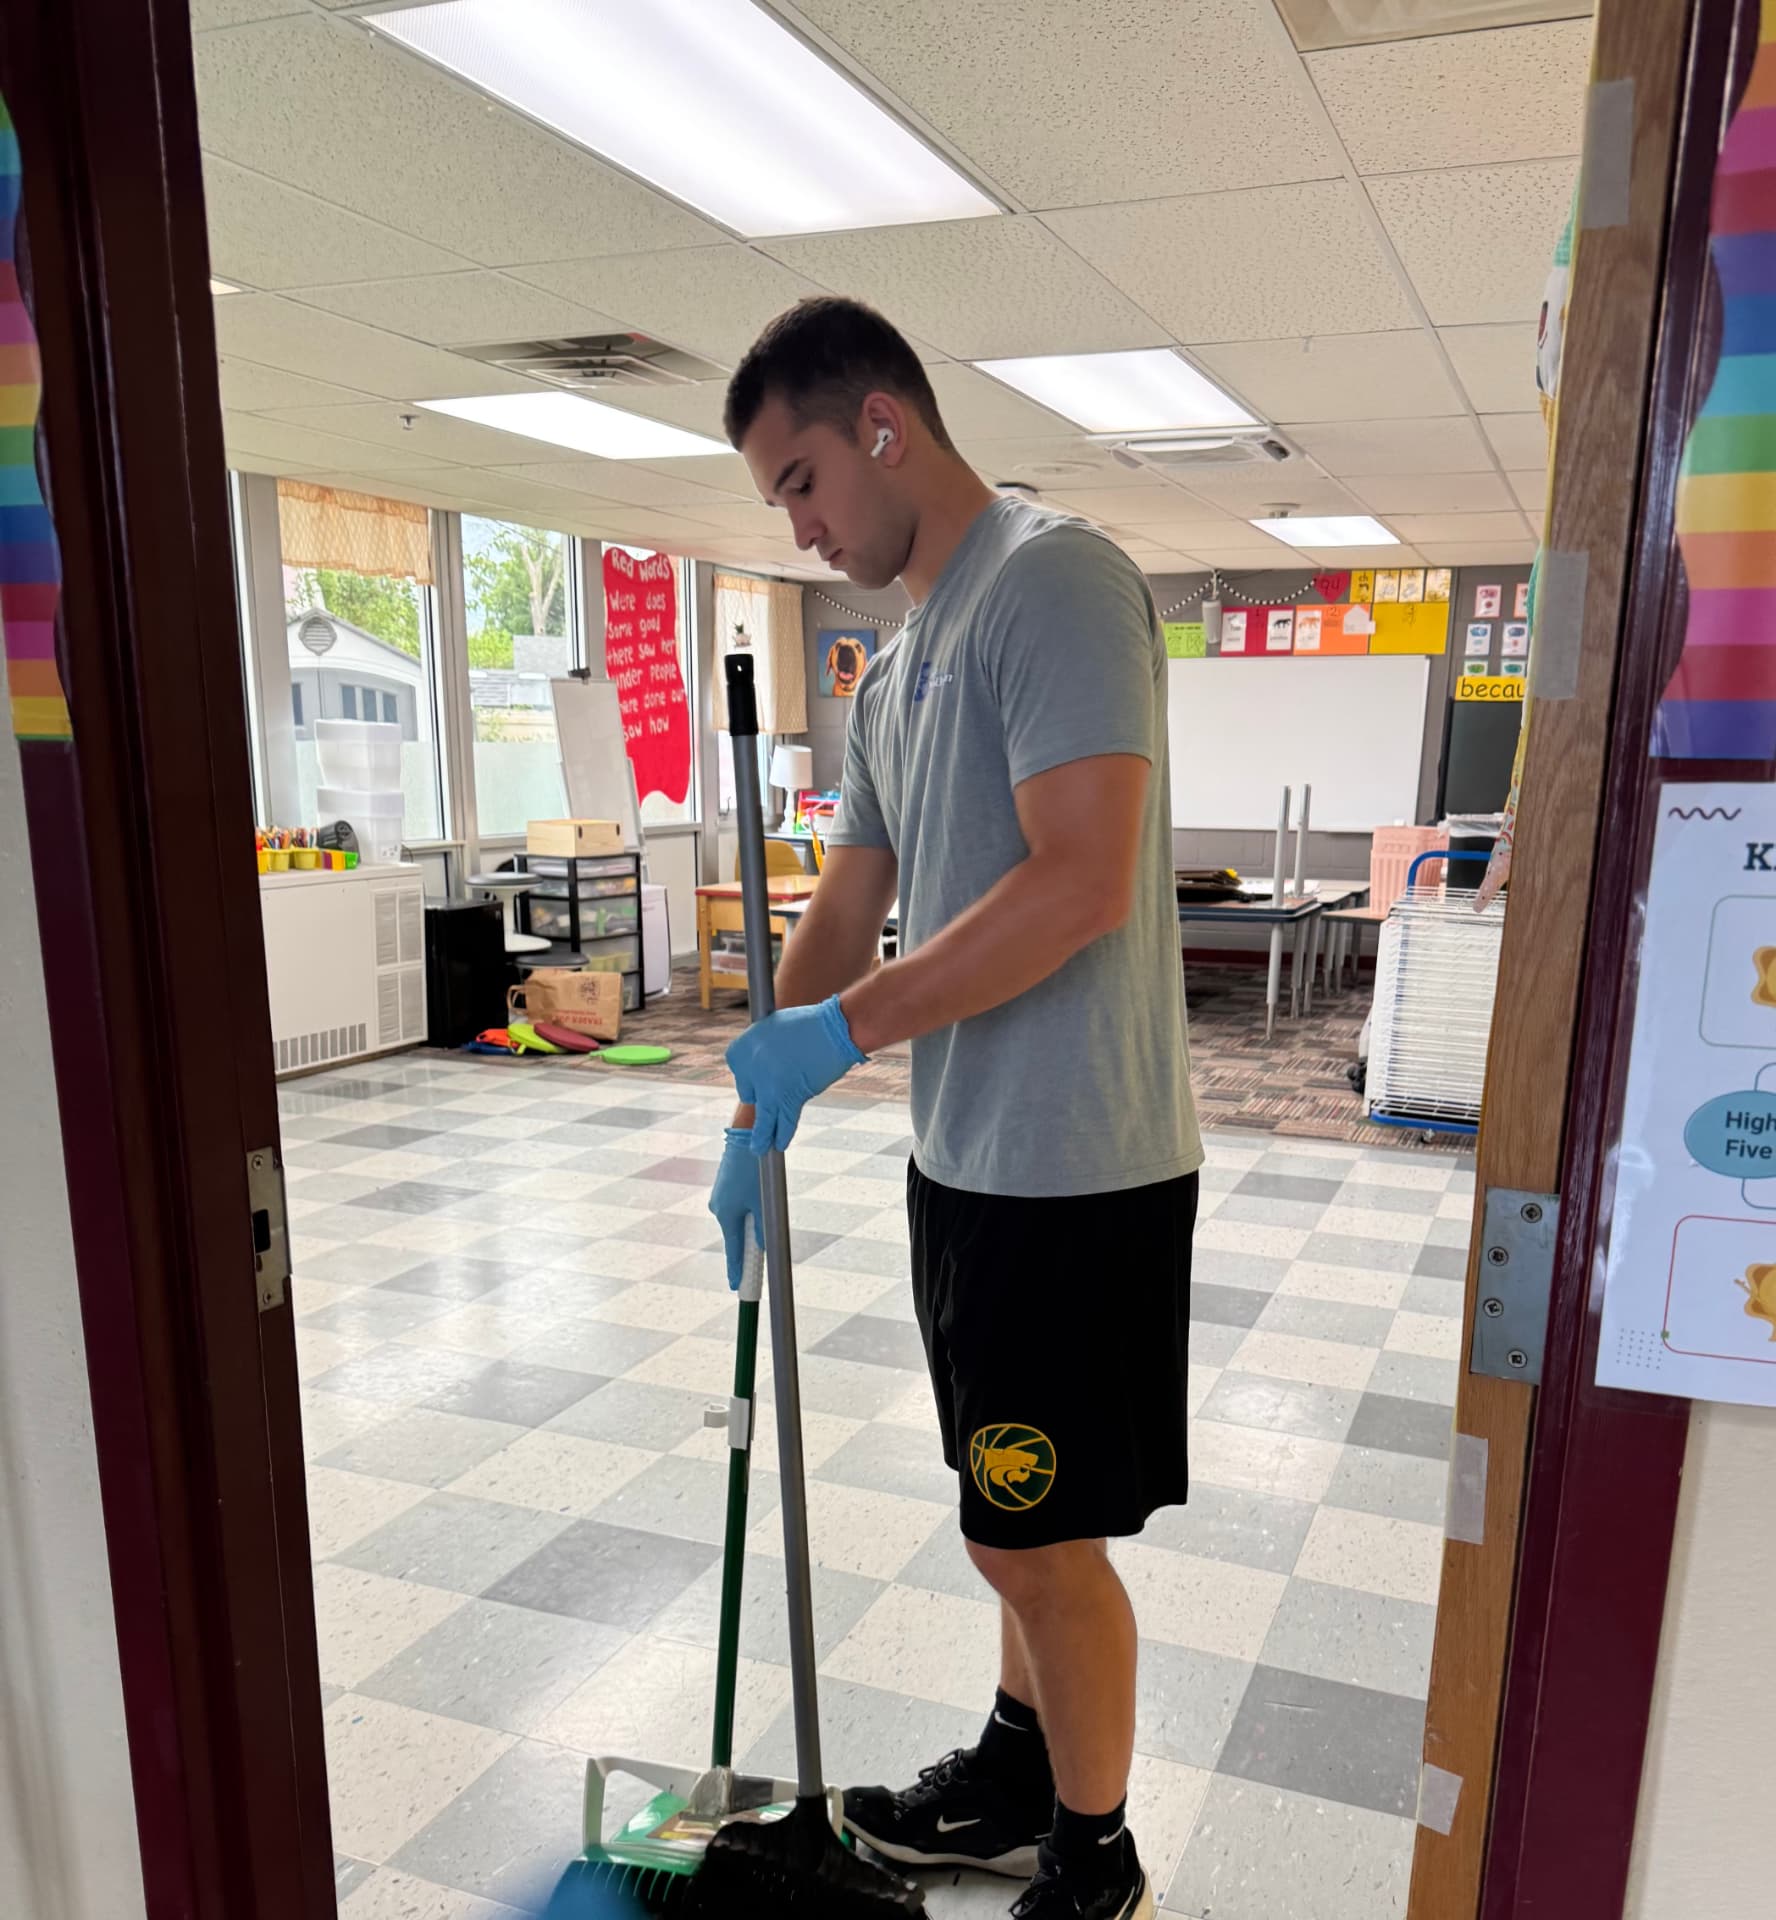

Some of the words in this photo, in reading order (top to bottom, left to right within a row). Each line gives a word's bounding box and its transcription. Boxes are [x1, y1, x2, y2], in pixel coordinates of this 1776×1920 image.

[612, 549, 634, 578] Red
[639, 555, 670, 581] Words
[640, 614, 661, 639] good
[607, 646, 634, 666] there
[649, 714, 670, 736] how
[1743, 842, 1776, 871] K
[1725, 1110, 1776, 1135] High
[1725, 1138, 1773, 1160] Five
